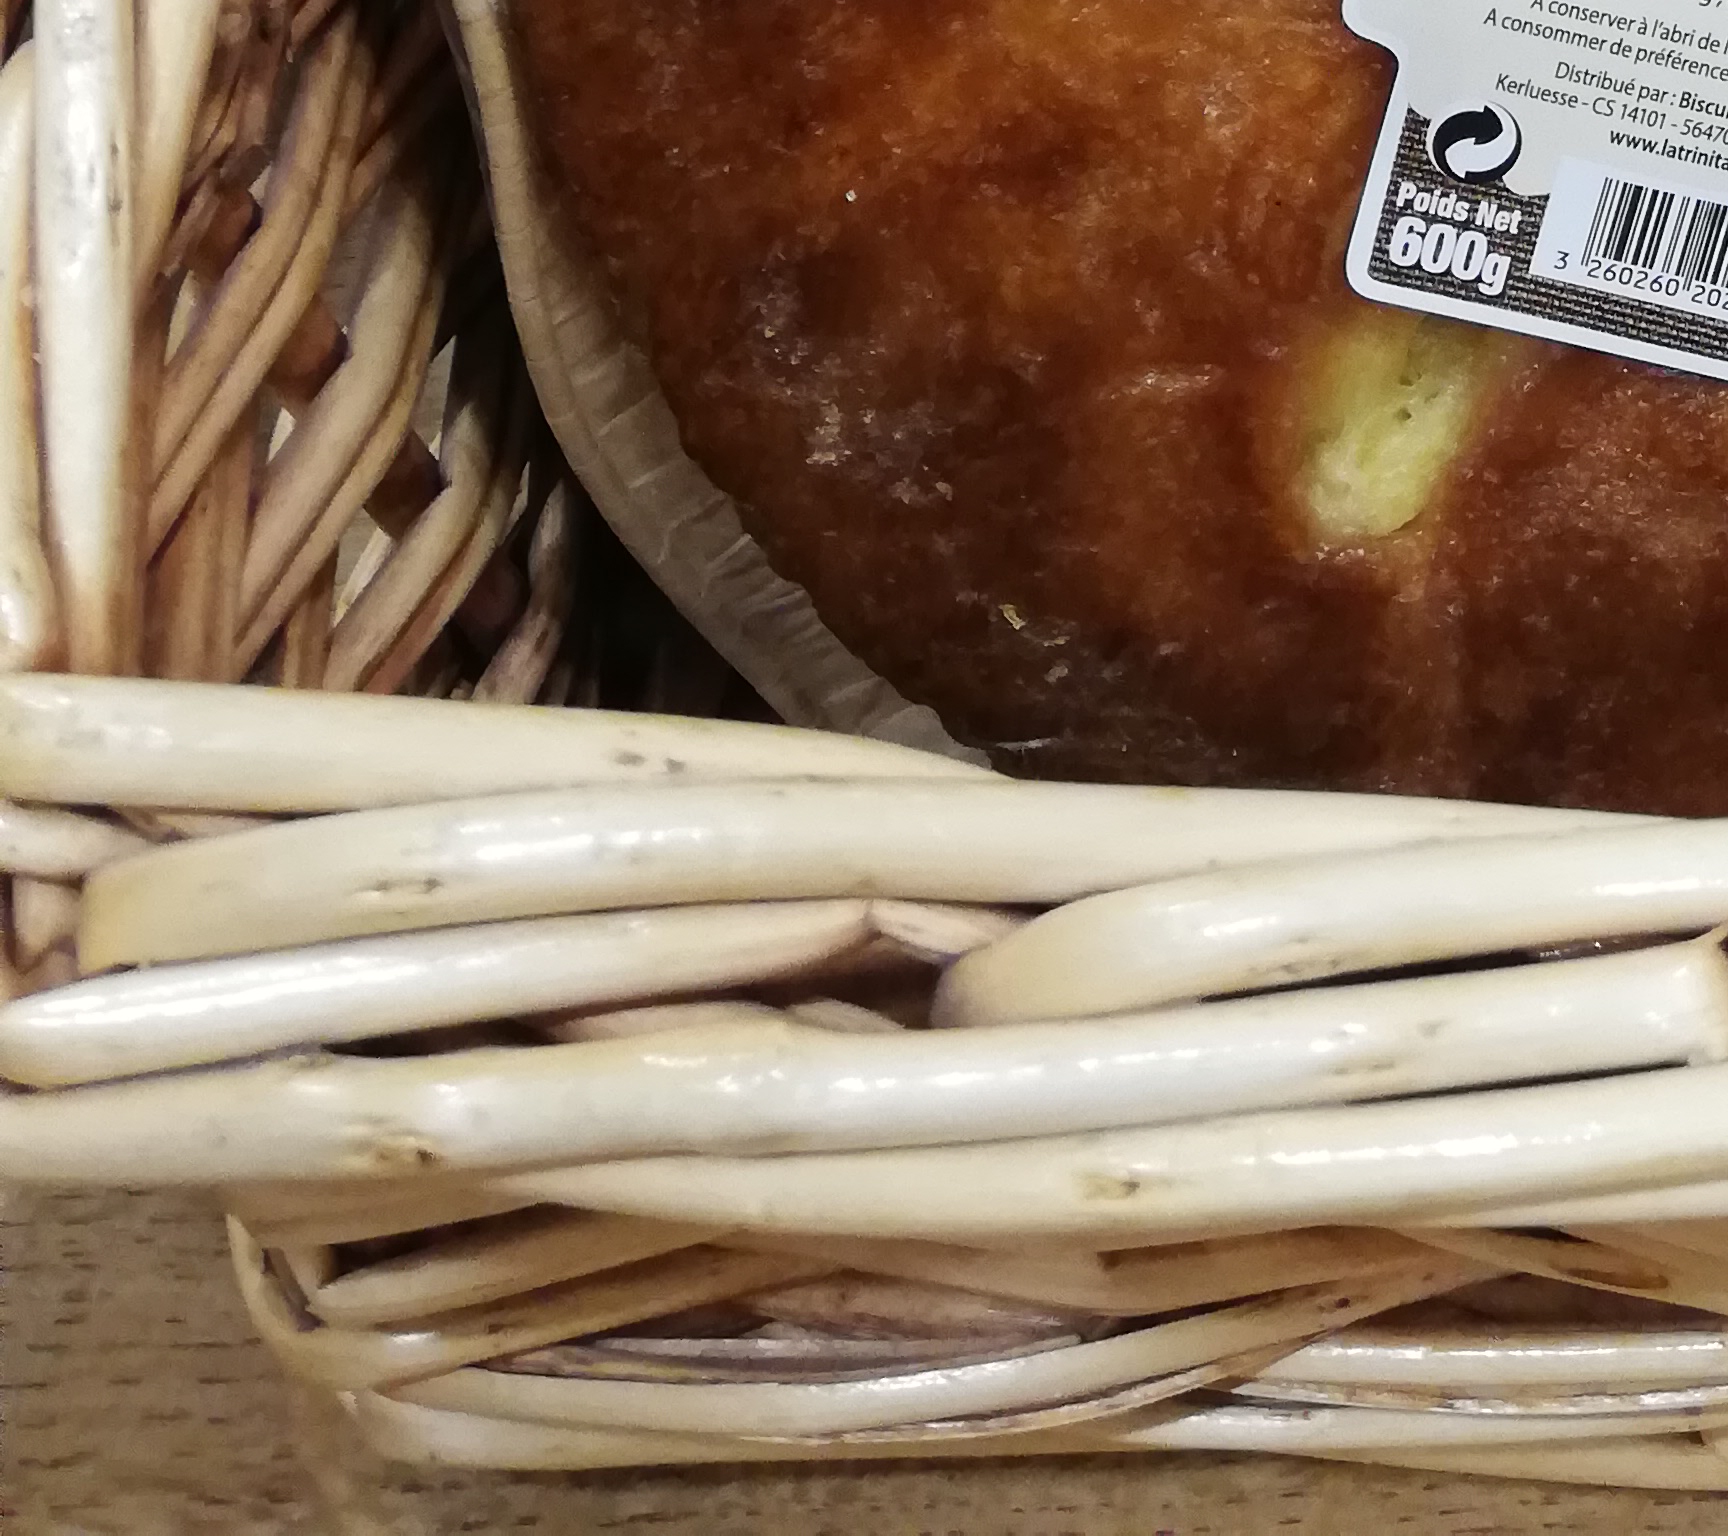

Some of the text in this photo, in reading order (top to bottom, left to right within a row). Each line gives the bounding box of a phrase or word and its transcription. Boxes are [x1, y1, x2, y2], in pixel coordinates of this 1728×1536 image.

[1482, 7, 1497, 27] A
[1500, 15, 1608, 52] consommer
[1608, 36, 1632, 58] de
[1547, 0, 1637, 32] conserver
[1636, 15, 1648, 36] à
[1696, 31, 1721, 53] de
[1494, 72, 1579, 109] Kerluesse
[1591, 96, 1617, 117] CS
[1619, 102, 1666, 130] 14101
[1554, 60, 1636, 96] Distribué
[1396, 181, 1525, 235] Poids Net
[1388, 216, 1512, 296] 600g
[1553, 250, 1569, 270] 3
[1586, 259, 1681, 298] 260260
